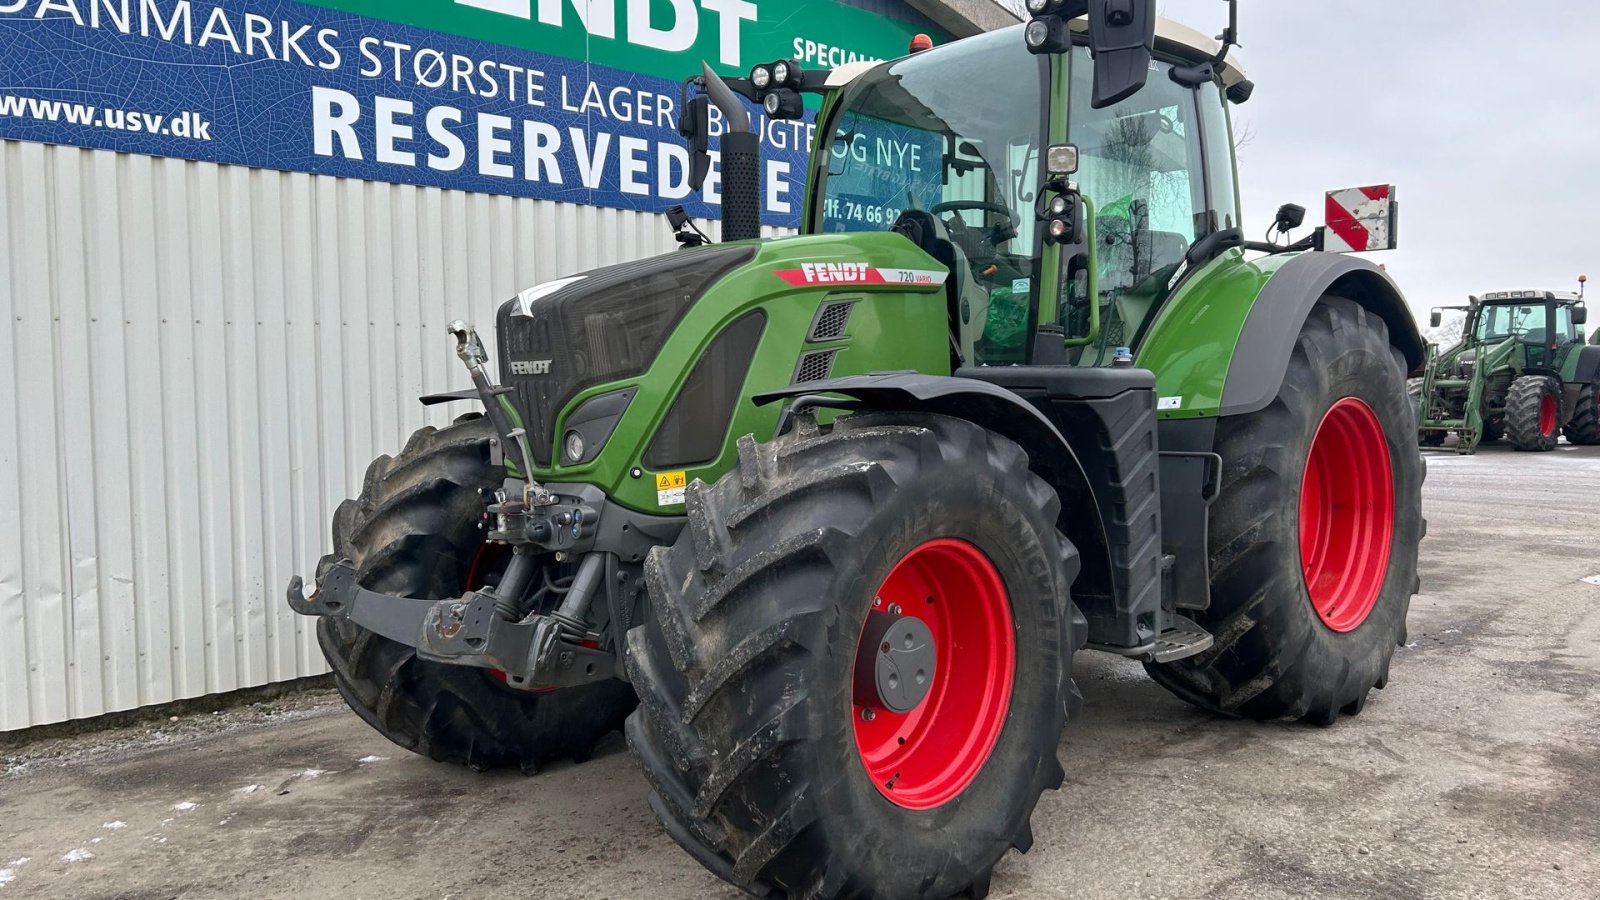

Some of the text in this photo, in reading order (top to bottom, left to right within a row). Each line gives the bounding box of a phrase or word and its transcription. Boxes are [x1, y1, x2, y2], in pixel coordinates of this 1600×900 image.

[793, 37, 888, 70] SPECI
[0, 0, 341, 70] ANMARKS
[359, 36, 545, 107] STØRSTE
[561, 75, 676, 130] LAGER
[831, 128, 867, 162] OG
[876, 138, 921, 171] NYE
[0, 95, 211, 140] www.usv.dk
[312, 86, 791, 214] RESERVEDEE
[846, 202, 862, 221] 74
[866, 205, 882, 224] 66
[801, 262, 869, 282] FENDT
[898, 271, 914, 283] 720
[511, 359, 552, 375] FENDT
